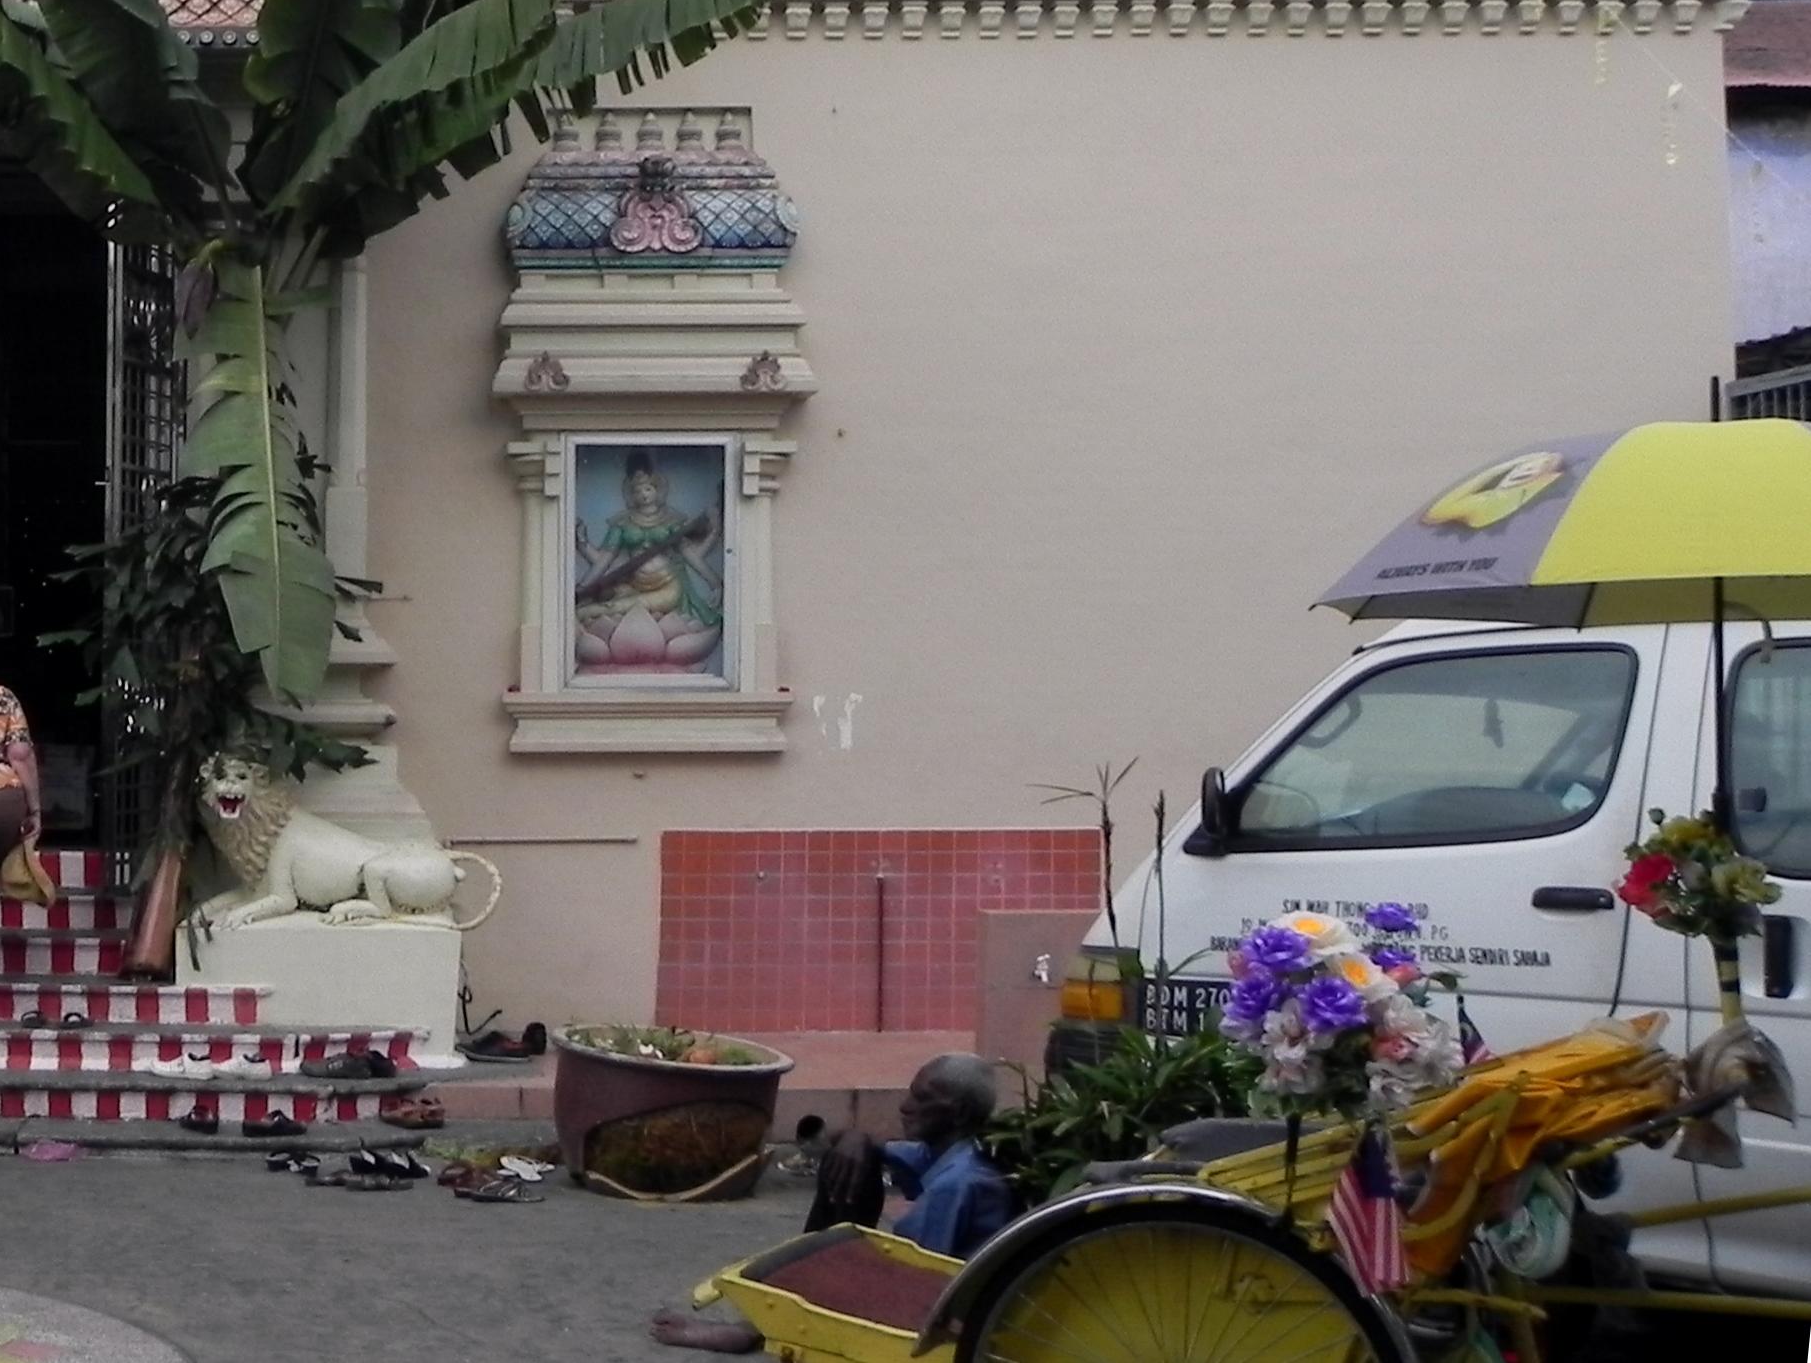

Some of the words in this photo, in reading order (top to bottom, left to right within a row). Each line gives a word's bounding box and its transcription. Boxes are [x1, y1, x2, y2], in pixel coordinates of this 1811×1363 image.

[1431, 560, 1468, 574] WITH
[1469, 557, 1498, 571] YOU
[1420, 945, 1466, 964] PEKERJA
